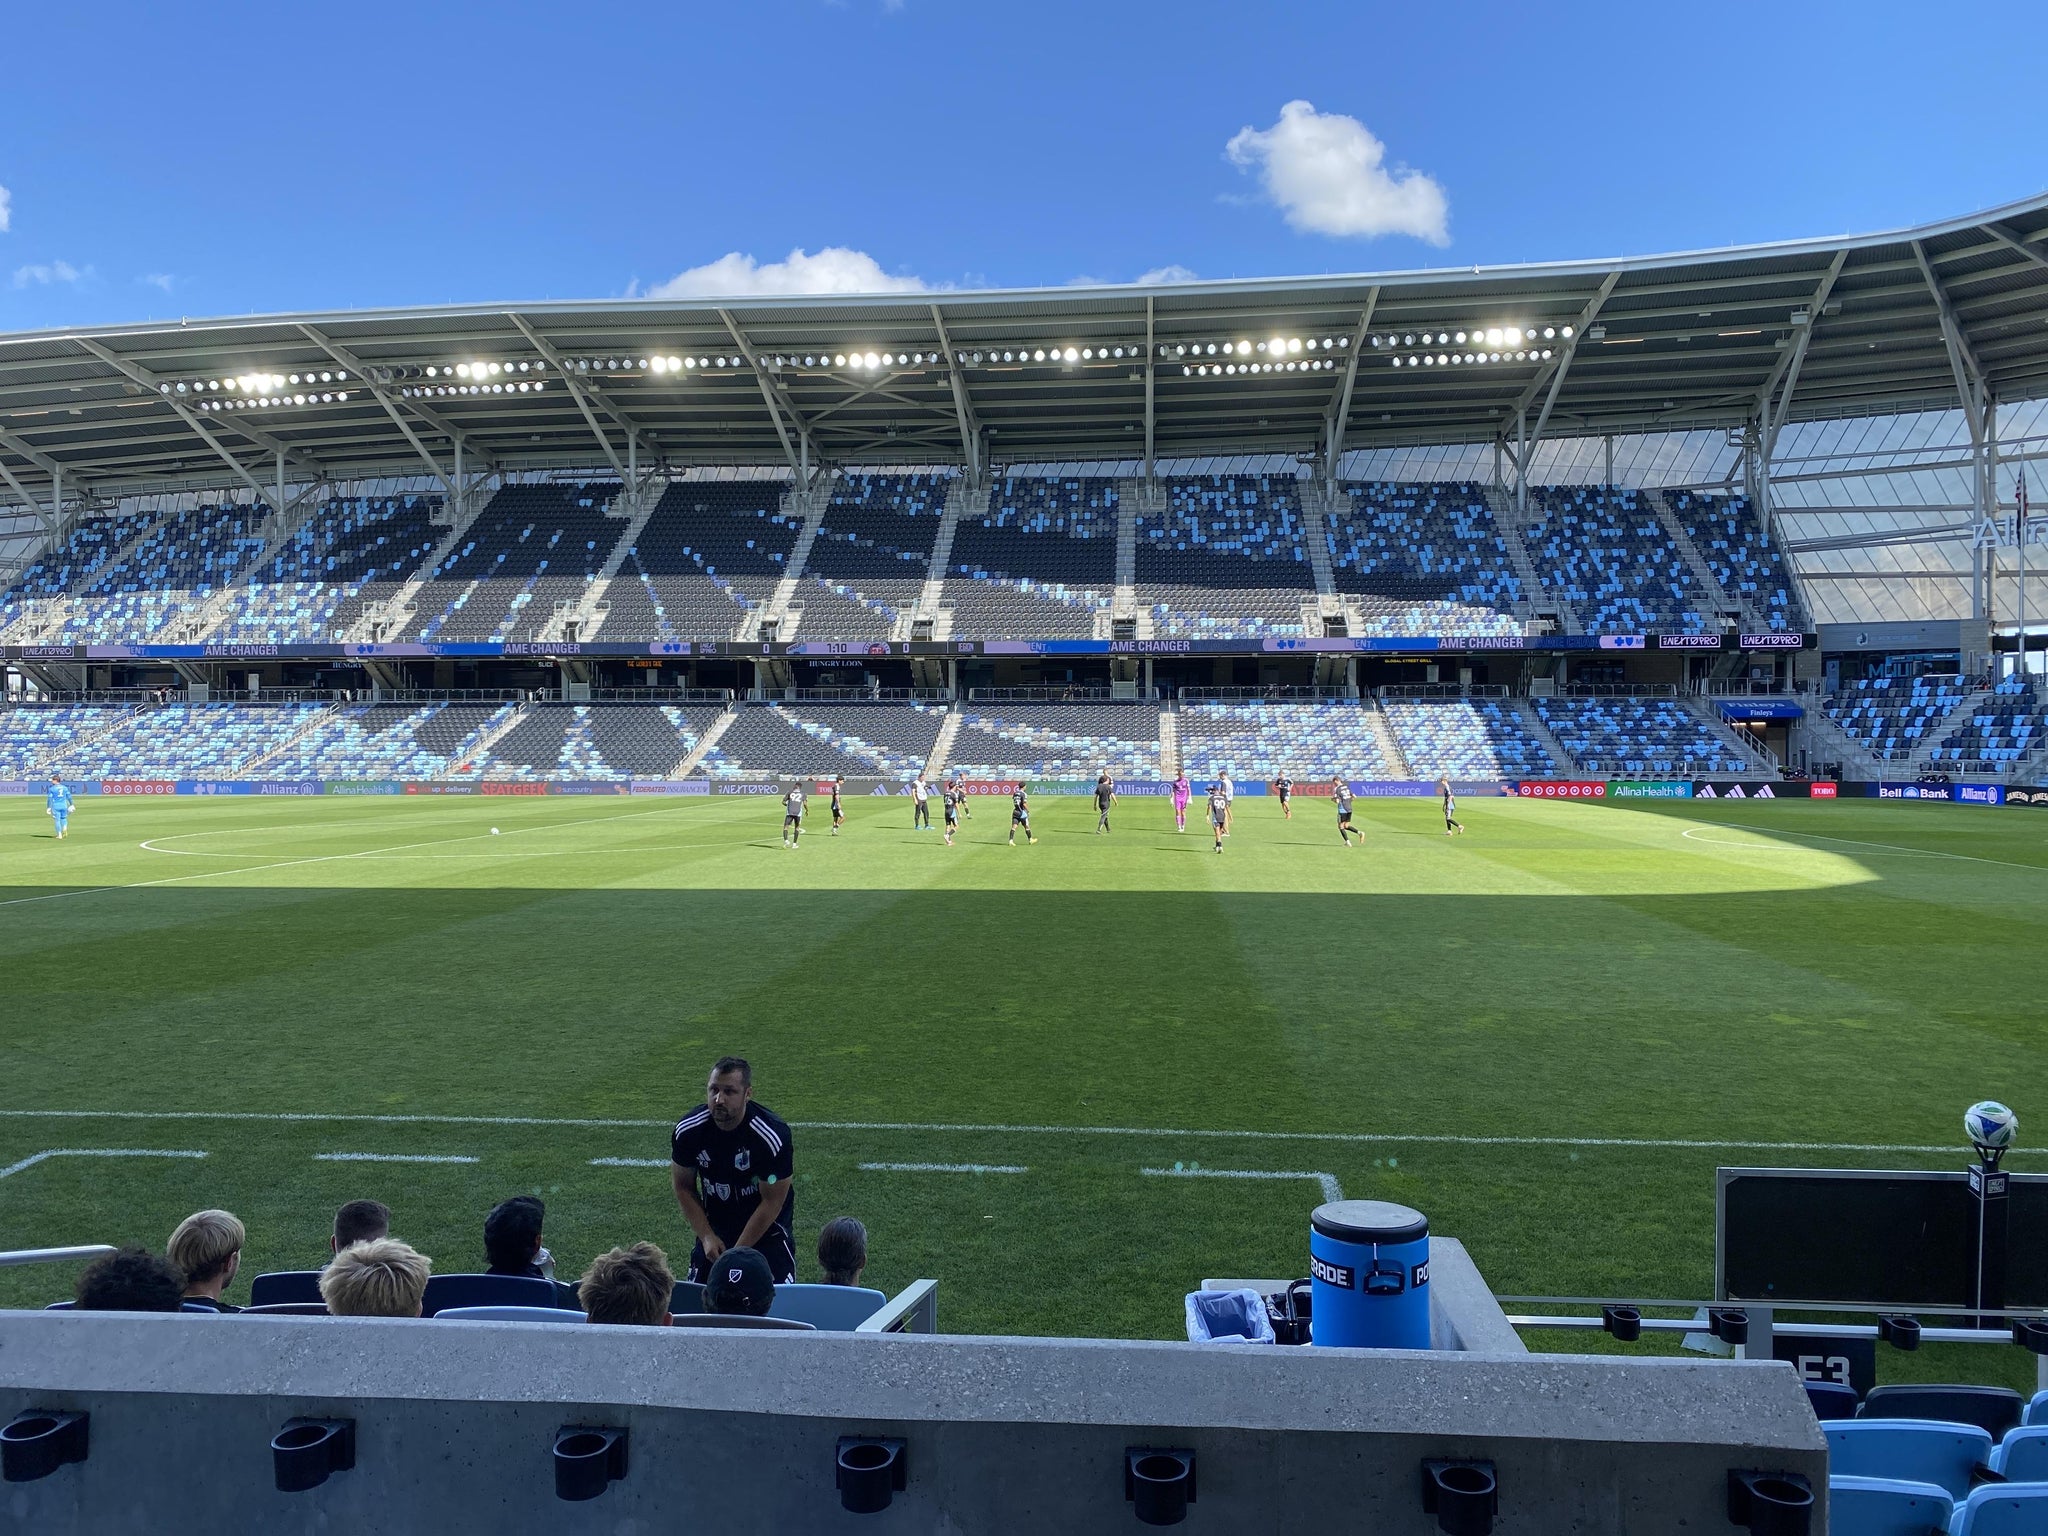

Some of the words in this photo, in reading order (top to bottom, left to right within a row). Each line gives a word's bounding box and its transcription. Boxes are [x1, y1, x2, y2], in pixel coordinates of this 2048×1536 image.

[502, 643, 528, 654] AME
[530, 643, 581, 654] CHANGER
[826, 643, 847, 653] 1:10
[1108, 641, 1135, 651] AME
[1138, 640, 1190, 651] CHANGER
[1437, 638, 1466, 649] AME
[1468, 637, 1524, 648] CHANGER
[202, 646, 228, 656] AME
[230, 645, 278, 656] CHANGER
[1750, 709, 1773, 717] Finleys
[218, 785, 233, 794] MN
[261, 783, 299, 795] Allianz
[481, 782, 548, 795] SEATGEEK
[632, 785, 666, 793] FEDERATED
[666, 785, 701, 793] INSURANCE
[1115, 784, 1156, 795] Allianz
[1361, 785, 1421, 796] NutriSource
[1813, 787, 1835, 795] TORO
[1880, 788, 1902, 798] Bell
[1920, 789, 1949, 799] Bank
[1961, 787, 1987, 800] Allianz
[789, 793, 803, 803] 92
[1213, 799, 1226, 810] 90
